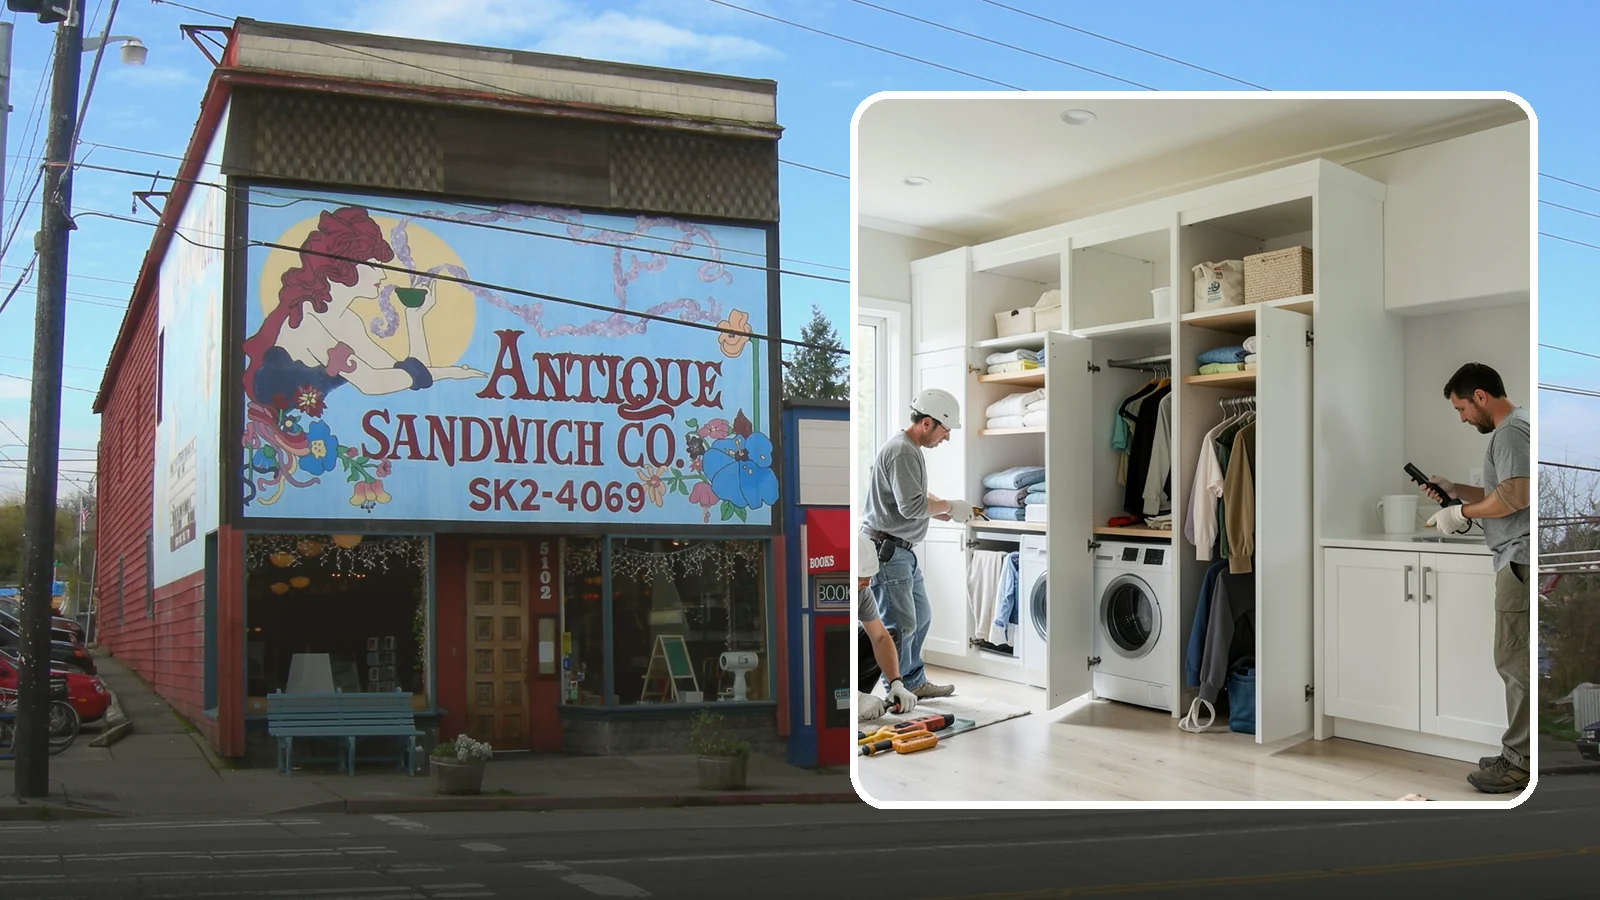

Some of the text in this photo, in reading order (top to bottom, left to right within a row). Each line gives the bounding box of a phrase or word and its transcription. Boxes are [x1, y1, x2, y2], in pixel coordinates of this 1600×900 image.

[477, 329, 722, 419] ANTIQUE
[362, 408, 684, 469] SANDWICH CO.
[469, 478, 646, 513] SK2-4069
[540, 541, 551, 600] 5102
[809, 555, 835, 569] BOOKS
